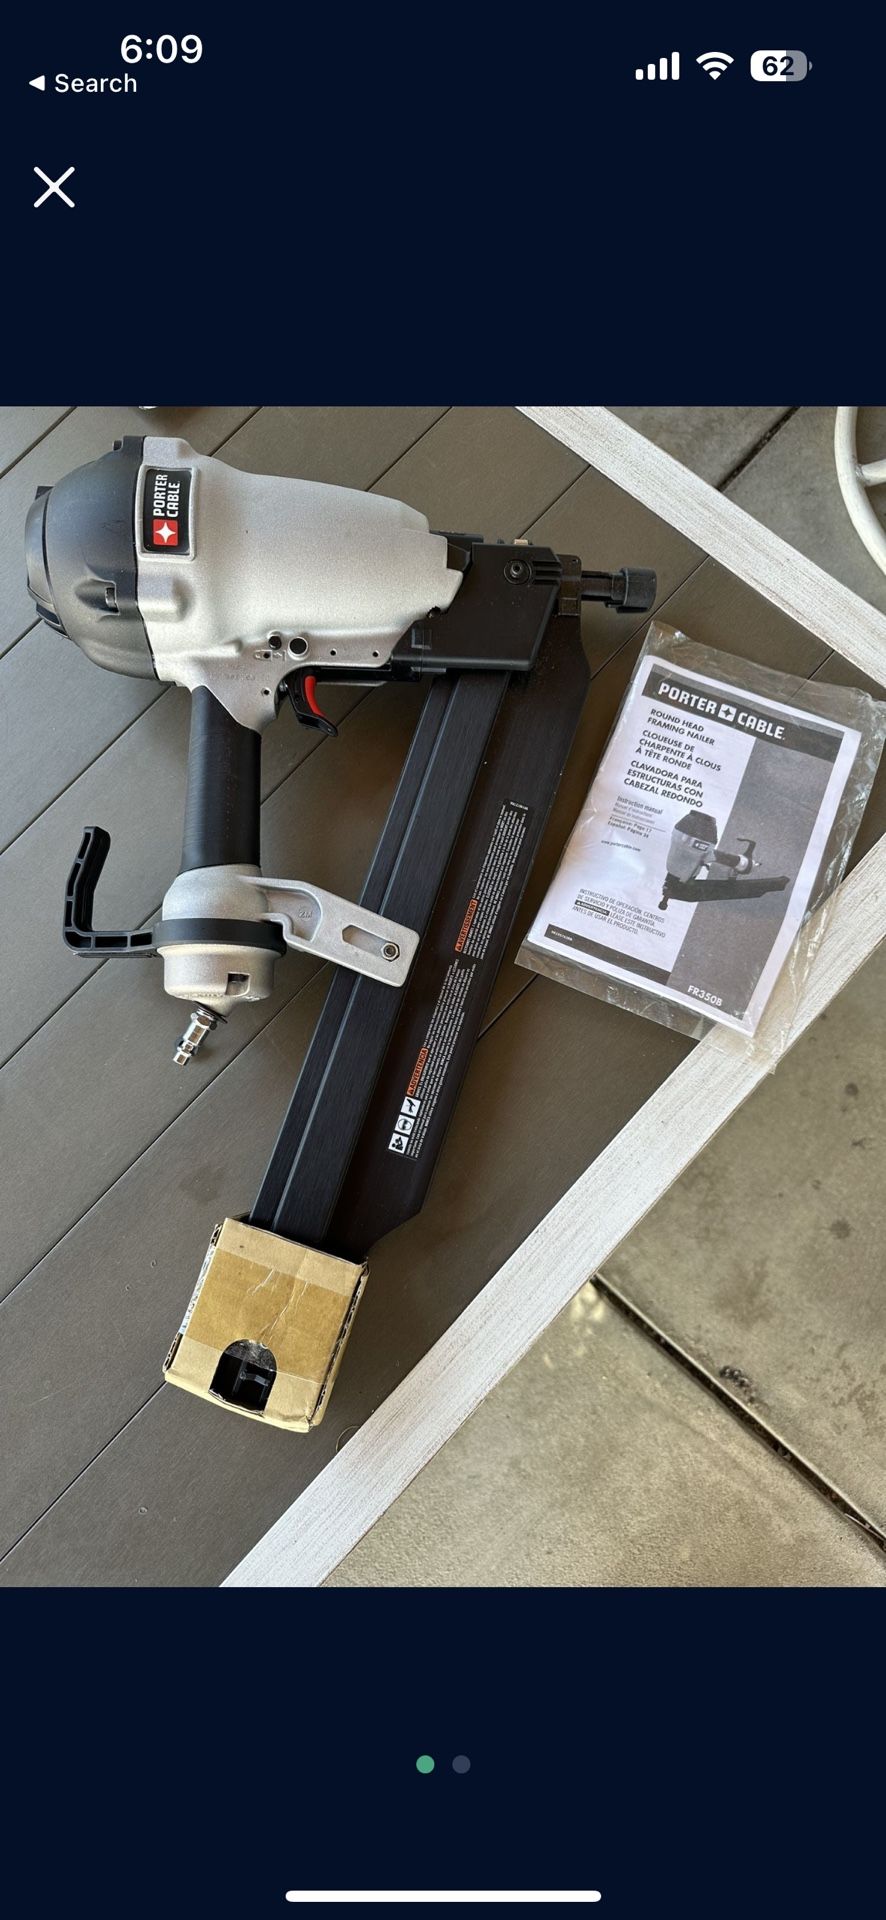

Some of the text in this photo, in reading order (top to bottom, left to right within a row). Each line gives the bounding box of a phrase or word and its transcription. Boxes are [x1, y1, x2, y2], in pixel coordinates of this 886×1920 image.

[153, 474, 168, 517] PORTER
[166, 482, 180, 518] CABLE
[651, 708, 704, 732] ROUND HEAD
[658, 682, 785, 740] PORTER CABLE
[642, 730, 695, 753] CLOUEUSE DE
[647, 717, 715, 746] FRAMING NAILER
[635, 746, 692, 770] À TÊTE RONDE
[639, 738, 721, 772] CHARPENTE À CLOUS
[627, 768, 704, 799] ESTRUCTURAS CON
[631, 760, 703, 789] CLAVADORA PARA
[617, 796, 644, 809] Instruction
[644, 805, 664, 815] manual
[624, 778, 703, 808] CABEZAL REDONDO
[572, 905, 586, 914] ANTES
[594, 912, 607, 922] USAR
[579, 888, 609, 902] INSTRUCTIVO
[643, 911, 665, 924] CENTROS
[585, 896, 605, 908] SERVICIO
[625, 911, 632, 919] DE
[457, 900, 478, 948] AVERTISSEMENT
[624, 918, 636, 926] ESTE
[636, 924, 666, 938] INSTRUCTIVO
[687, 984, 723, 1007] FR350B
[409, 1049, 428, 1090] ADVERTENCIA
